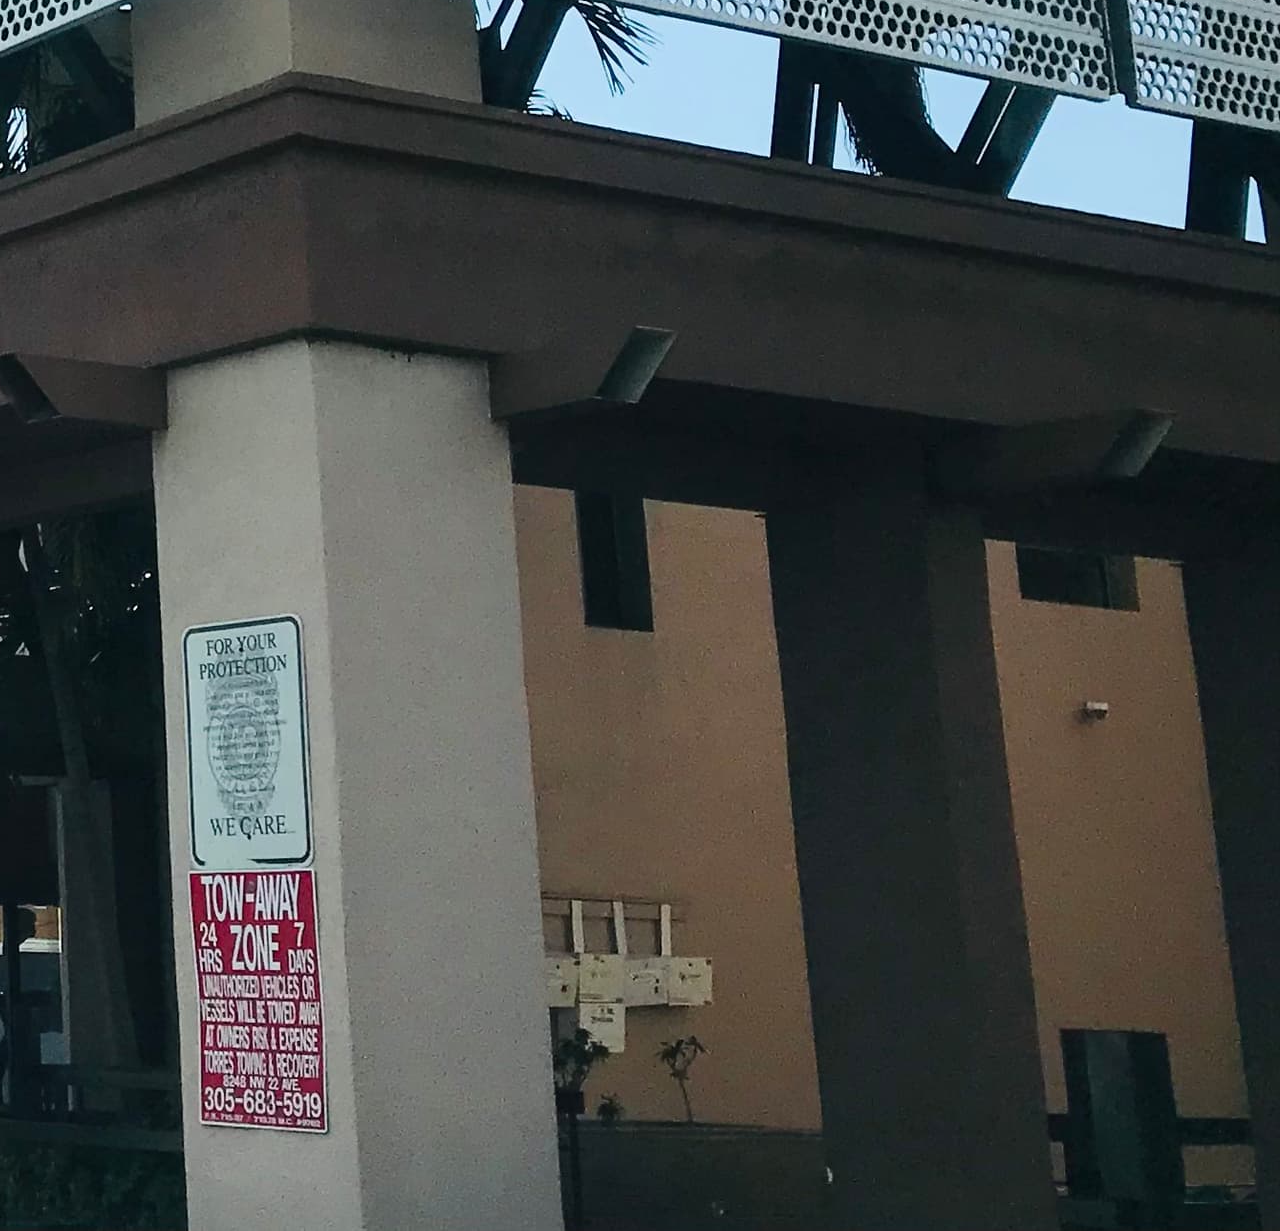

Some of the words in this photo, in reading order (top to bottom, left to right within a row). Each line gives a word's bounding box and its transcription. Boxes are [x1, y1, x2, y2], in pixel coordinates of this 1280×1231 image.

[206, 638, 232, 656] FOR
[236, 632, 277, 652] YOUR
[199, 655, 288, 680] PROTECTION
[210, 817, 235, 836] WE
[240, 815, 287, 837] CARE
[200, 874, 300, 922] TOW-AWAY
[199, 922, 218, 947] 24
[294, 922, 305, 947] 7
[230, 924, 281, 972] ZONE
[198, 949, 223, 973] HRS
[288, 949, 315, 974] DAYS
[202, 975, 260, 998] UNAUTHORIZED
[261, 975, 300, 999] VEHICLES
[302, 976, 316, 999] OR
[200, 999, 235, 1022] VESSELS
[236, 1000, 256, 1023] WILL
[267, 1000, 296, 1024] TOWED
[205, 1025, 215, 1047] AT
[252, 1026, 269, 1050] RISK
[279, 1027, 318, 1052] EXPENSE
[236, 1051, 266, 1075] TOWING
[276, 1053, 320, 1078] RECOVERY
[249, 1076, 266, 1089] NW
[268, 1077, 279, 1090] 22
[204, 1086, 322, 1118] 305-683-5919
